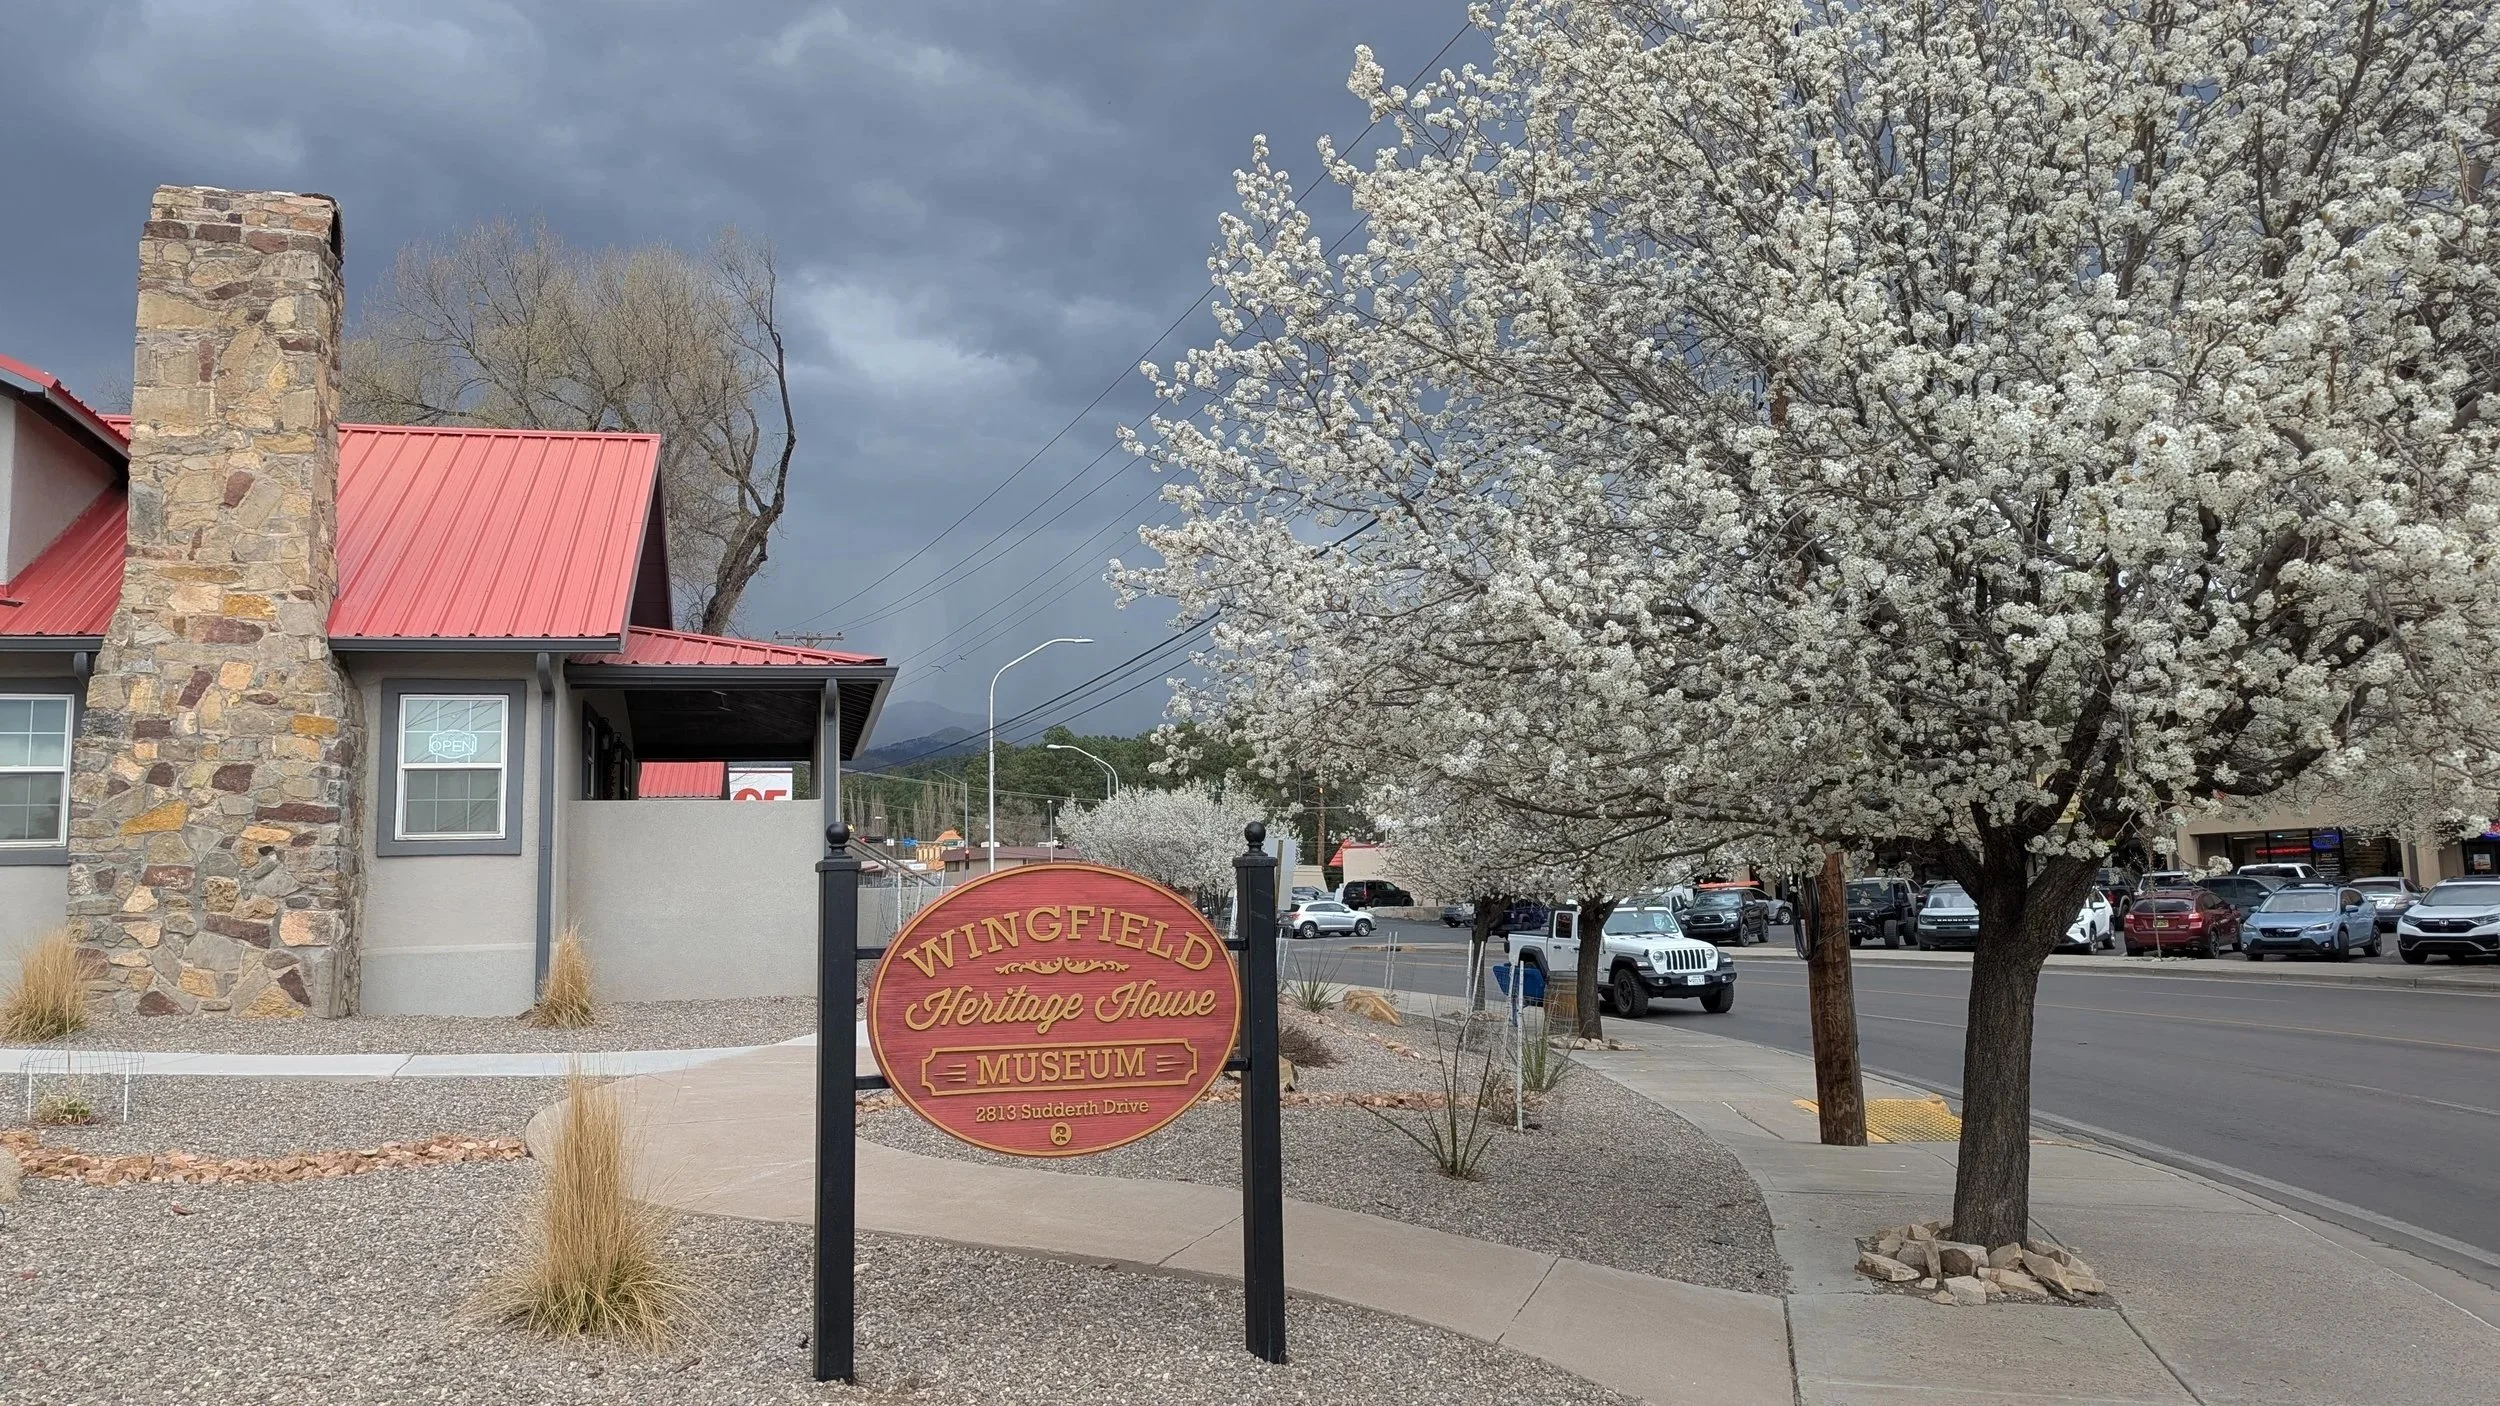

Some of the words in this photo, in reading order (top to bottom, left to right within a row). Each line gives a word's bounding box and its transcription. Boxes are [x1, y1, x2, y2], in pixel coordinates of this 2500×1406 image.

[431, 740, 474, 752] OPEN
[902, 905, 1213, 978] WINGFIELD
[905, 985, 1084, 1034] Heritage
[1095, 979, 1216, 1023] House
[976, 1047, 1146, 1085] MUSEUM
[976, 1105, 1017, 1123] 2813
[1021, 1101, 1099, 1119] Sudderth
[1103, 1098, 1149, 1115] Drive
